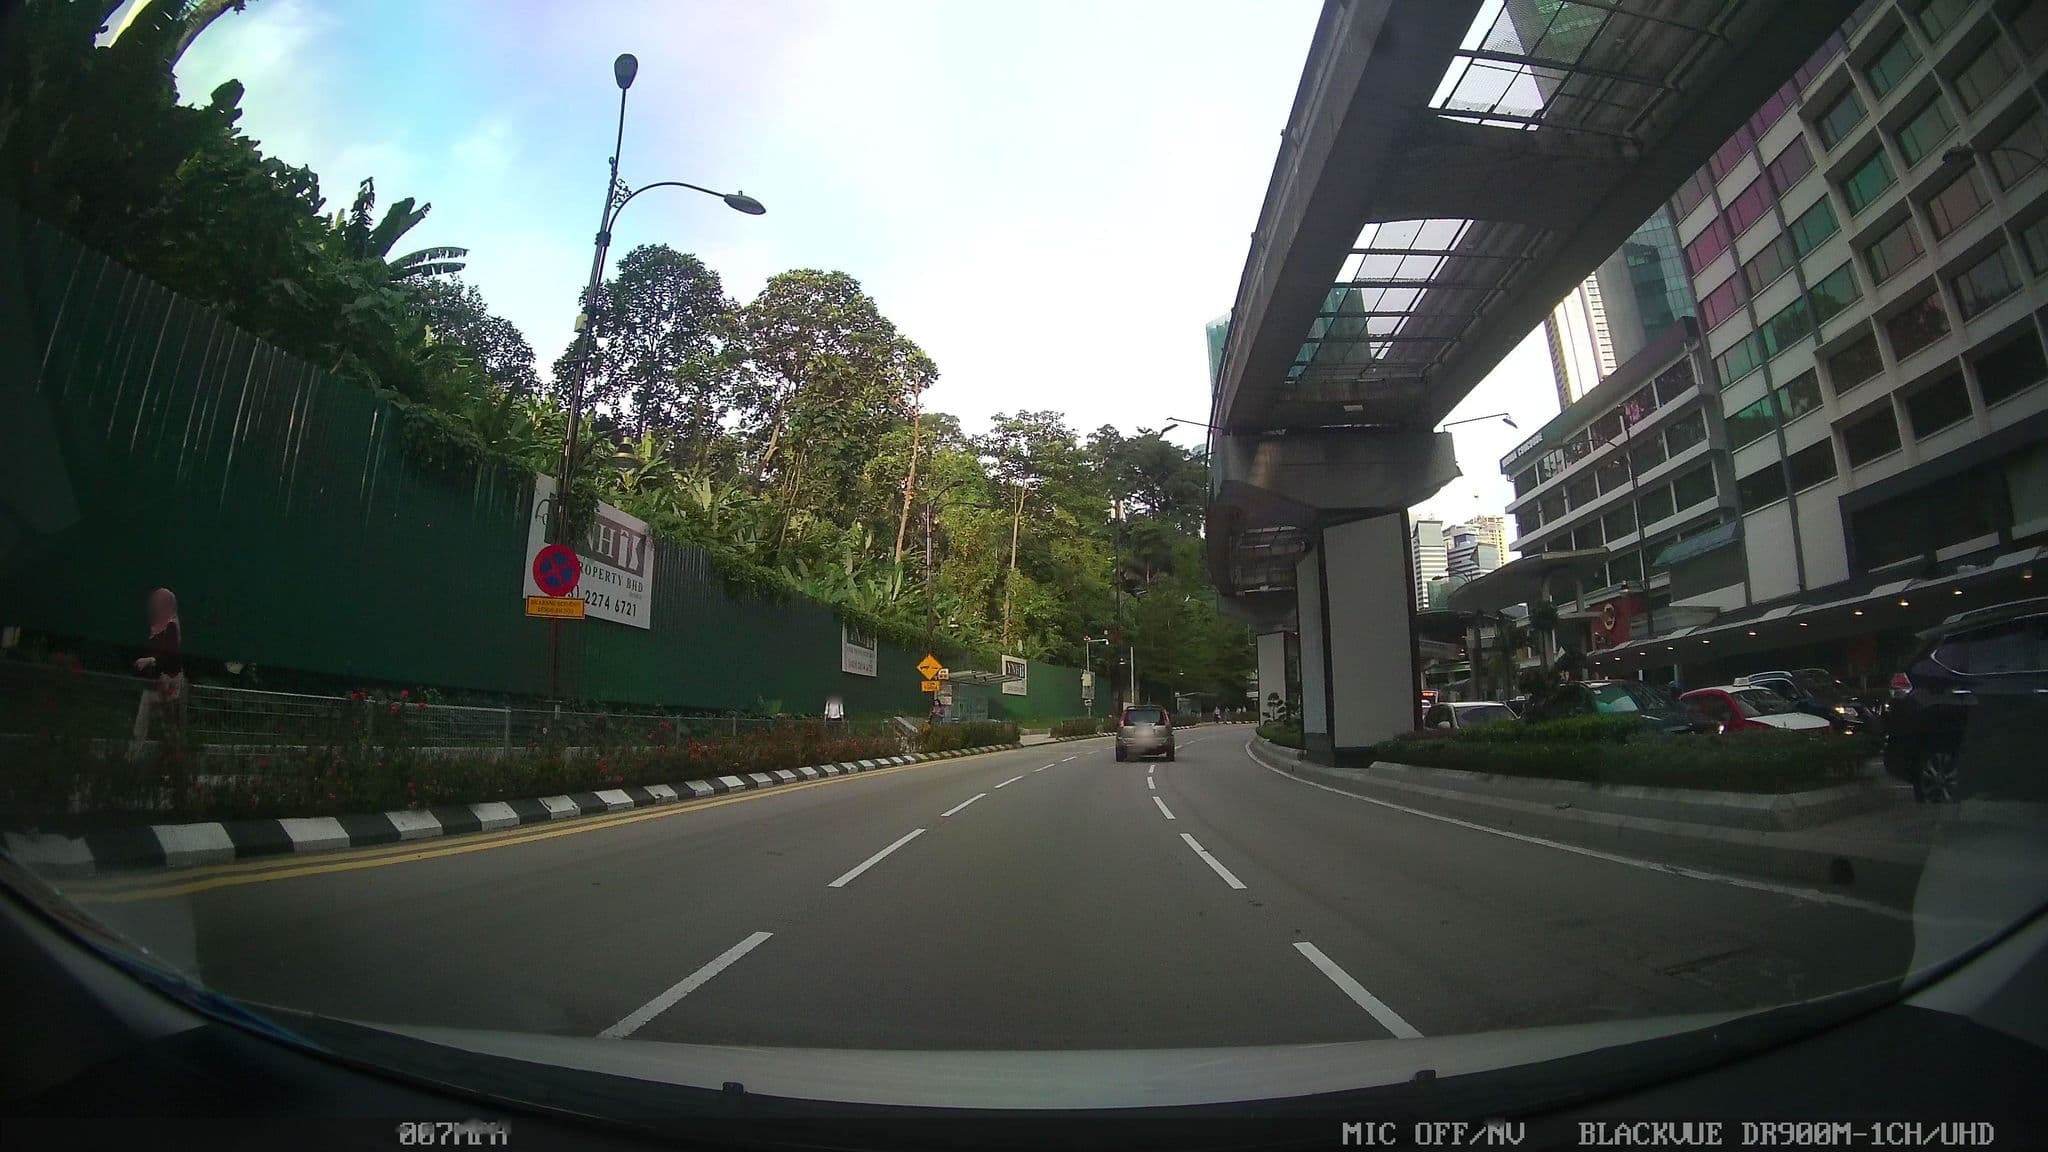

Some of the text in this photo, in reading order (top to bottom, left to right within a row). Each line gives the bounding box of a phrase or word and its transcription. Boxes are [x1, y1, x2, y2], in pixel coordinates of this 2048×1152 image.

[578, 561, 643, 593] ROPERTY BHD
[585, 590, 610, 611] 2274
[614, 600, 637, 617] 6721
